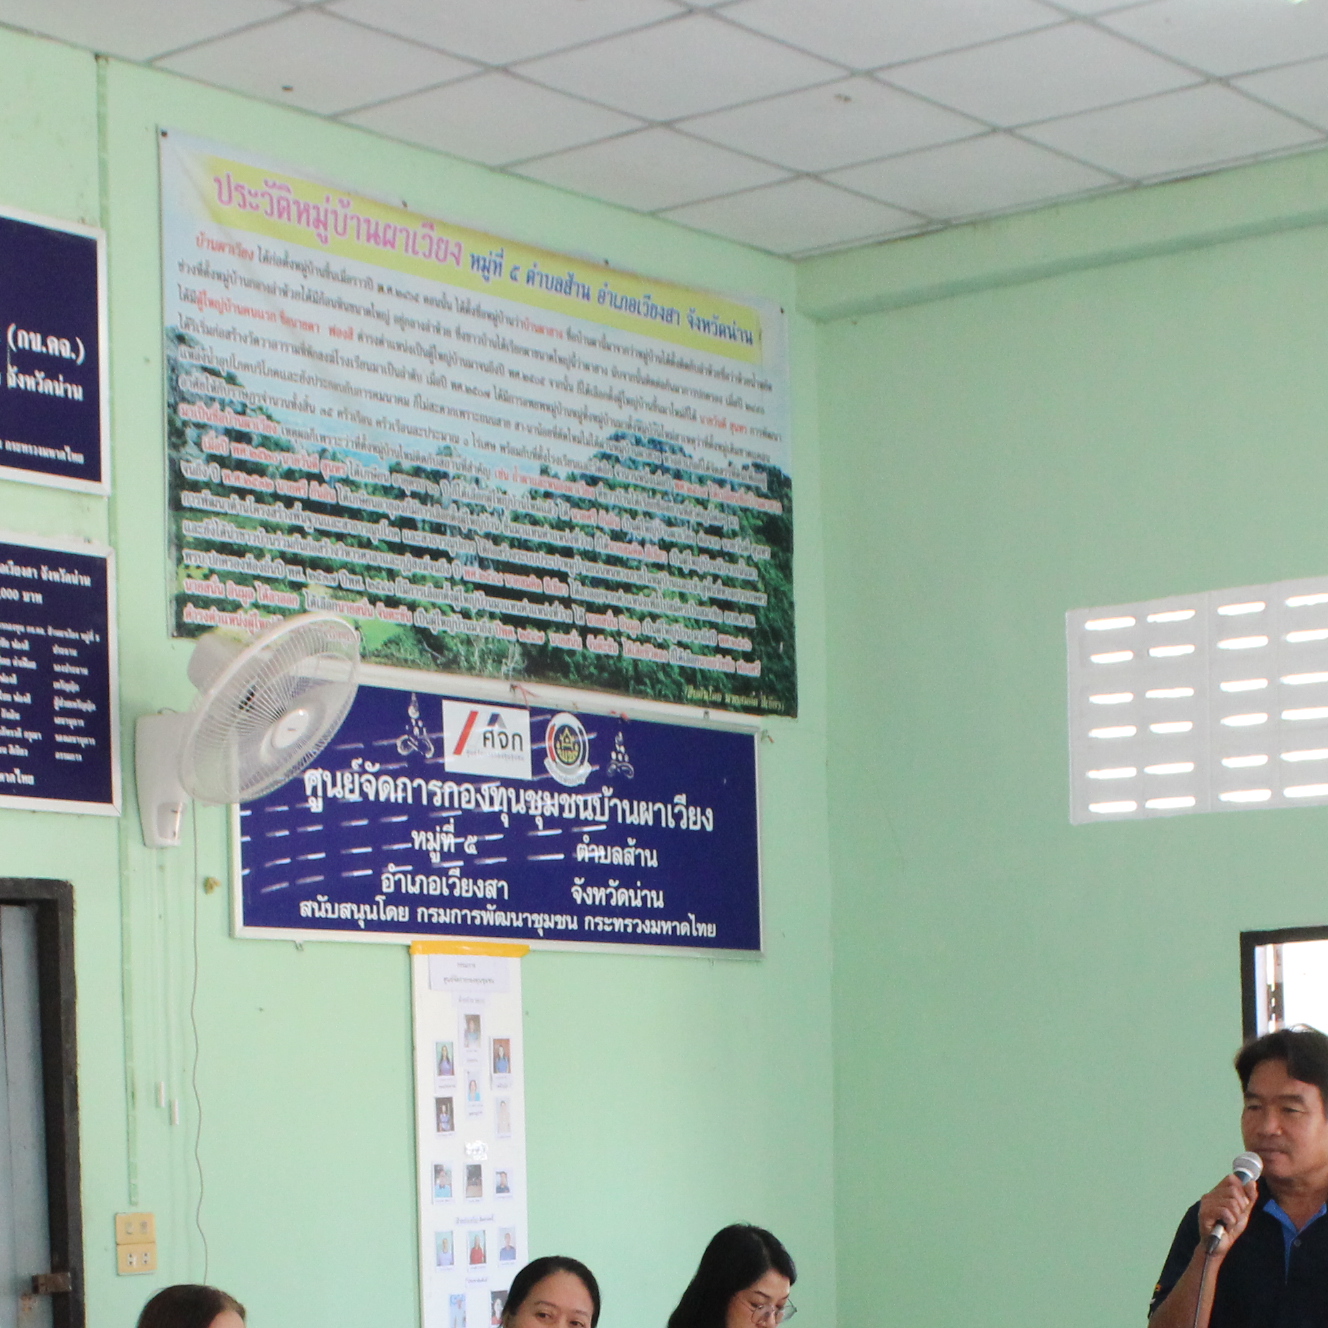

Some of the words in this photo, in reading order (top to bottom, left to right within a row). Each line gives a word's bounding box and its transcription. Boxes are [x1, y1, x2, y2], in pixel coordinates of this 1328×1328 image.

[214, 172, 462, 266] ประวัติหมู่บ้านผาเวียง
[469, 249, 504, 281] หมู่ที่
[526, 263, 591, 300] ตำบลส้าน
[598, 284, 681, 327] อำเภอเวียงสา
[687, 308, 753, 346] จังหวัดน่าน
[303, 758, 714, 832] ศูนย์จัดการกองทุนชุมชนบ้านผาเวียง
[411, 819, 456, 863] หมู่ที่
[576, 836, 657, 868] ตำบลส้าน
[381, 866, 509, 900] อำเภอเวียงสา
[571, 877, 664, 909] จังหวัดน่าน
[299, 896, 409, 929] สนับสนุนโดย
[417, 904, 578, 937] กรมการพัฒนาชุมชน
[584, 912, 716, 938] กระทรวงมหาดไทย
